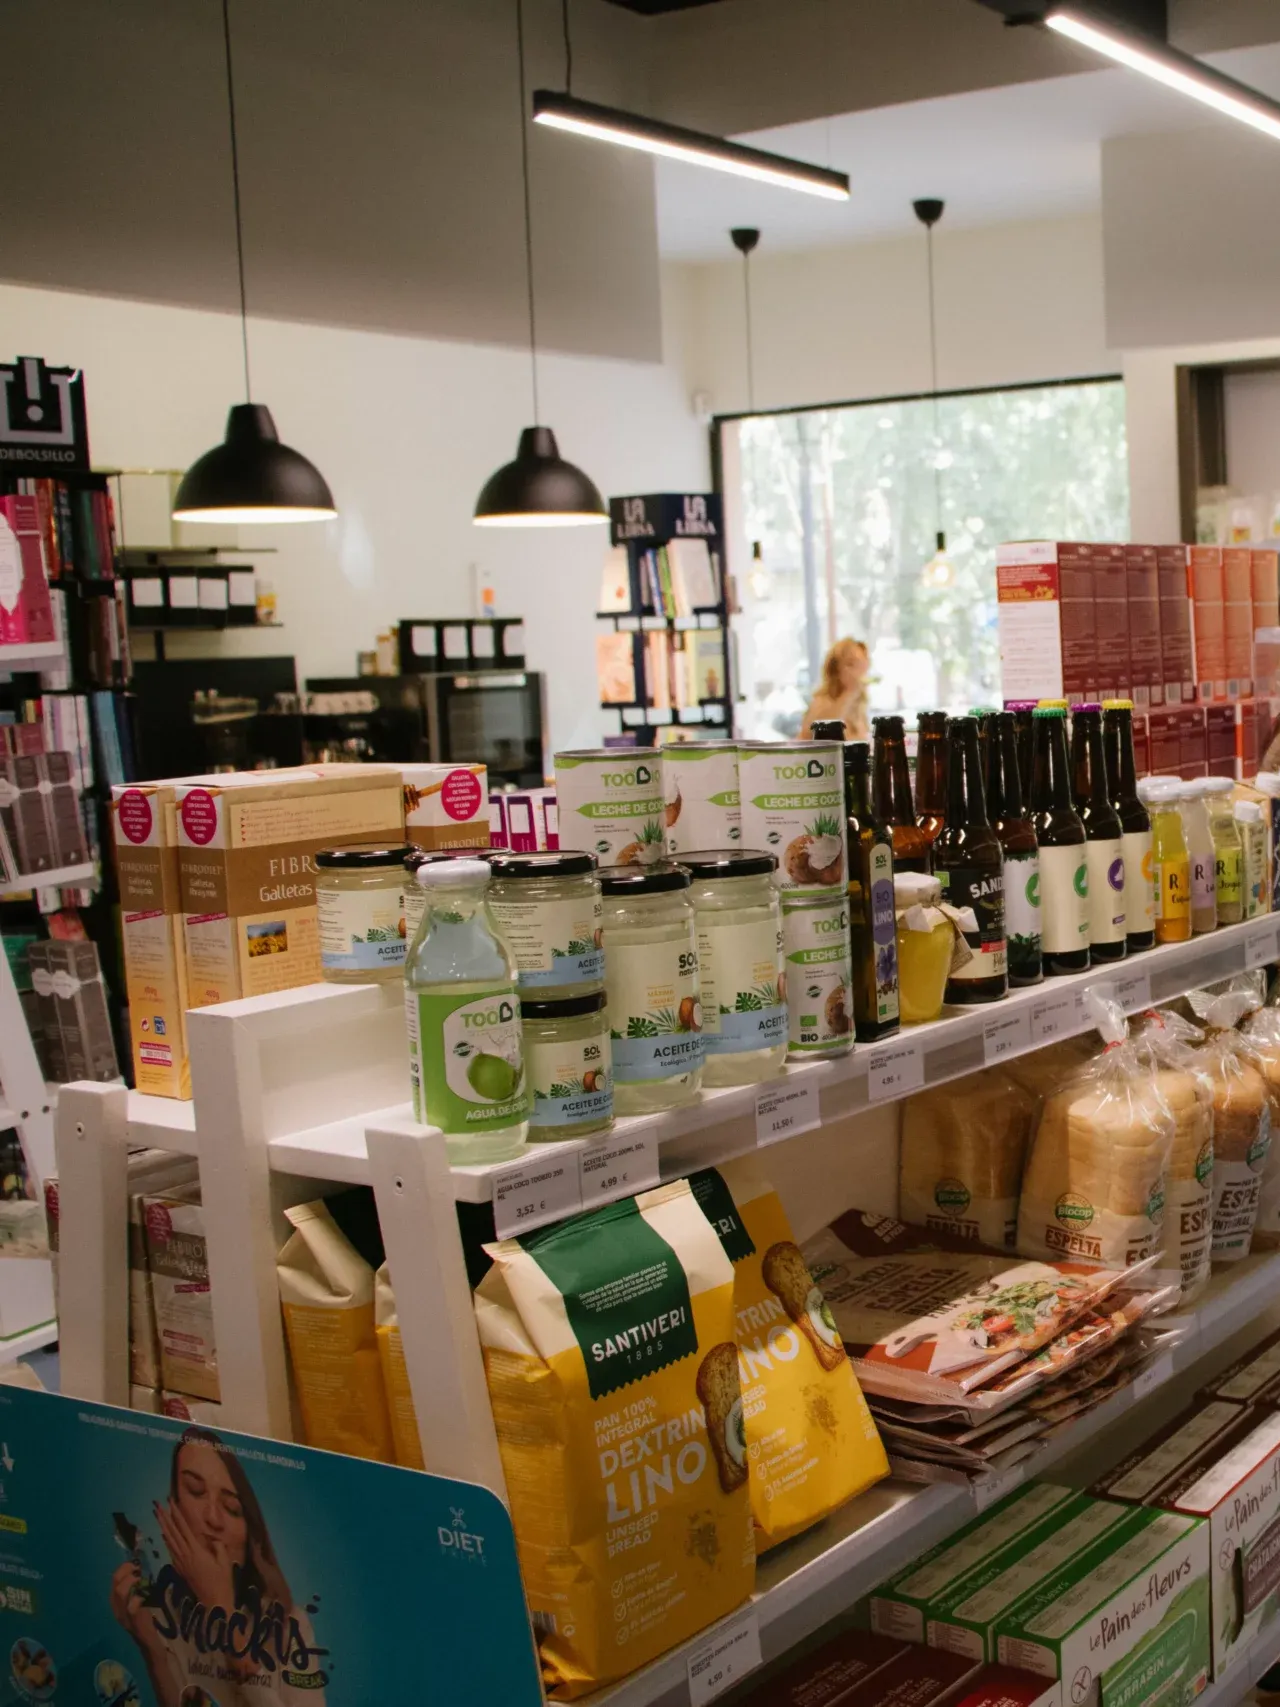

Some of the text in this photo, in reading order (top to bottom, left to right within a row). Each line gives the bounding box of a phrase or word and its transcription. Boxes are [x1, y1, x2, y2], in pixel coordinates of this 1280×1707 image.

[773, 759, 837, 780] TOOBIO
[592, 804, 631, 816] LECHE
[633, 803, 647, 814] DE
[764, 795, 801, 808] LECHE
[803, 795, 819, 806] DE
[259, 883, 313, 903] Galletas
[874, 909, 893, 925] LINO
[678, 952, 698, 969] SOL
[803, 950, 837, 963] LECHE
[800, 1033, 819, 1043] BIO
[584, 1045, 601, 1057] SOL
[653, 1042, 691, 1058] ACEITE
[466, 1108, 497, 1121] AGUA
[562, 1098, 592, 1112] ACEITE
[583, 1155, 602, 1168] ACEITE
[602, 1151, 618, 1161] COCO
[497, 1183, 513, 1195] AGUA
[513, 1179, 530, 1190] COCO
[601, 1176, 618, 1190] 4,99
[1218, 1186, 1259, 1209] ESPE
[516, 1200, 546, 1218] 3,52 €
[1057, 1205, 1092, 1219] Biocop
[1045, 1229, 1101, 1258] ESPELTA
[734, 1296, 786, 1337] TRIN
[591, 1306, 686, 1362] SANTIVERI
[738, 1325, 801, 1385] INO
[594, 1395, 658, 1433] PAN 100%
[595, 1412, 657, 1447] INTEGRAL
[600, 1404, 708, 1479] DEXTRIN
[606, 1441, 706, 1523] LINO
[1234, 1491, 1260, 1532] Pain
[1259, 1483, 1272, 1500] des
[438, 1526, 484, 1554] DIET
[608, 1530, 652, 1560] BREAD
[1089, 1556, 1192, 1652] Le Pain des fleurs
[1110, 1655, 1165, 1707] SARRASIN
